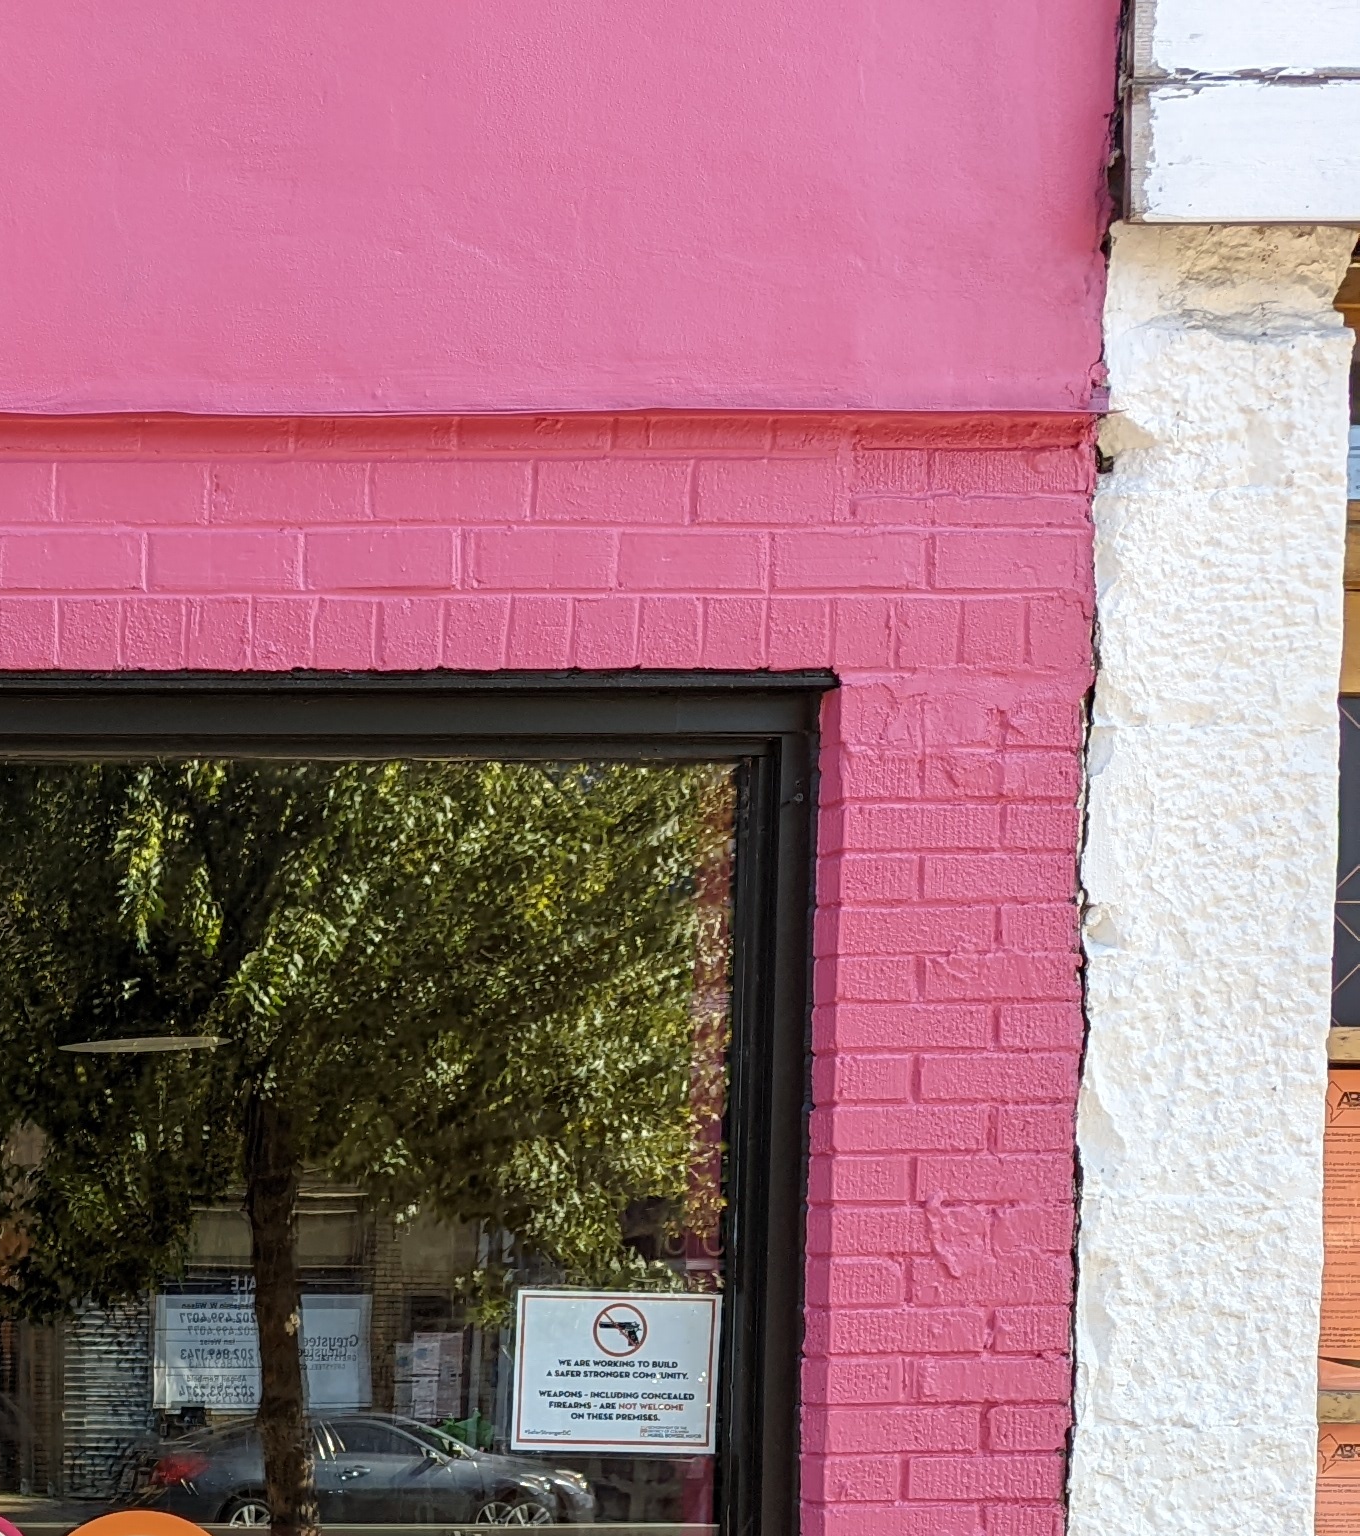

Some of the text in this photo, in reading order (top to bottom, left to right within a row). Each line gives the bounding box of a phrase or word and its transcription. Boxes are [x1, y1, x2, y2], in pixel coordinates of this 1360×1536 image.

[558, 1359, 678, 1369] WE ARE WORKING TO BUILD
[554, 1370, 581, 1378] SAFER
[583, 1371, 630, 1379] STRONGER
[539, 1390, 583, 1398] WEAPONS
[590, 1391, 640, 1400] INCLUDING
[641, 1392, 695, 1401] CONCEALED
[549, 1401, 592, 1410] FIREARMS
[599, 1402, 617, 1410] ARE
[639, 1403, 684, 1411] WELCOME
[571, 1412, 661, 1422] ON THESE PREMISES.
